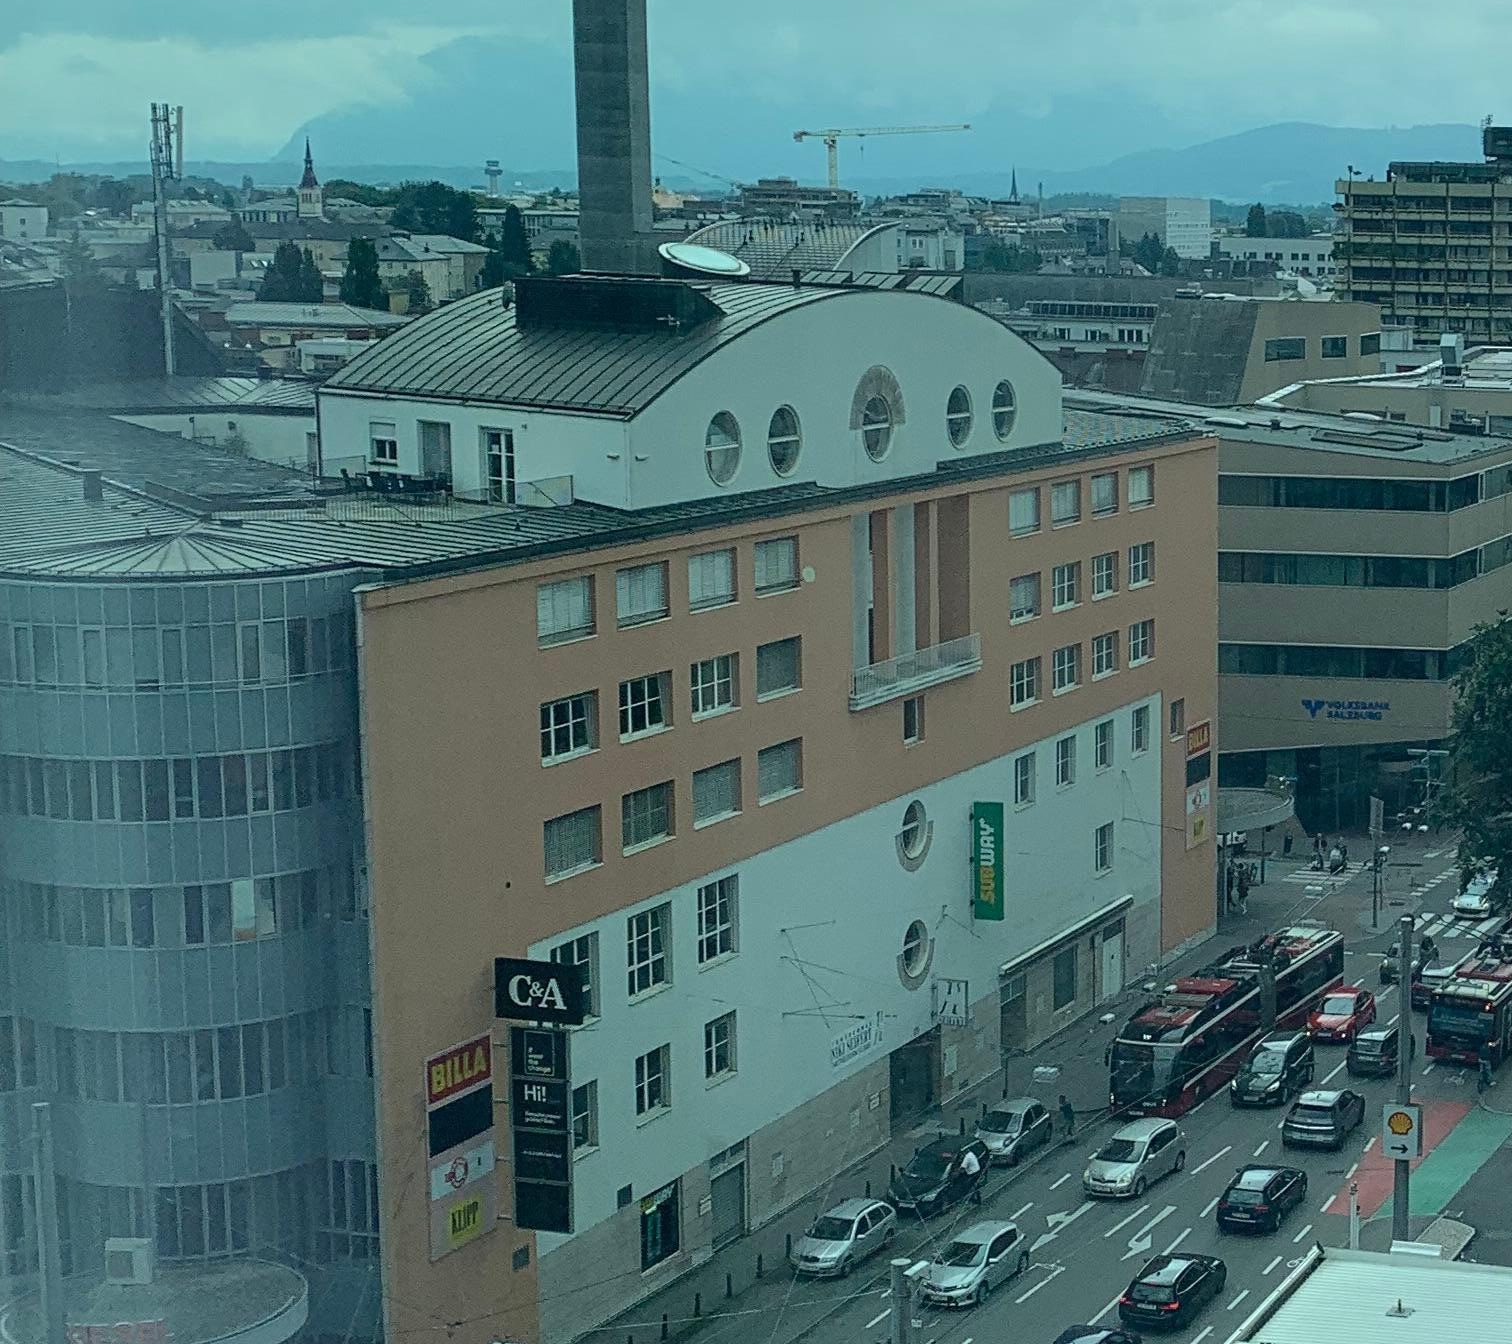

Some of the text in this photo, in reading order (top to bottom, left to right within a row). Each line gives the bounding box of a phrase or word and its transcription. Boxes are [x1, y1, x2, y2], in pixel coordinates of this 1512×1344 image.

[1326, 701, 1391, 711] VOLKSBANK
[1326, 711, 1382, 720] SALZBURG
[979, 817, 995, 905] SUBWAY
[508, 974, 567, 1010] C&A
[430, 1045, 486, 1095] BILLA
[524, 1084, 546, 1102] Hi!
